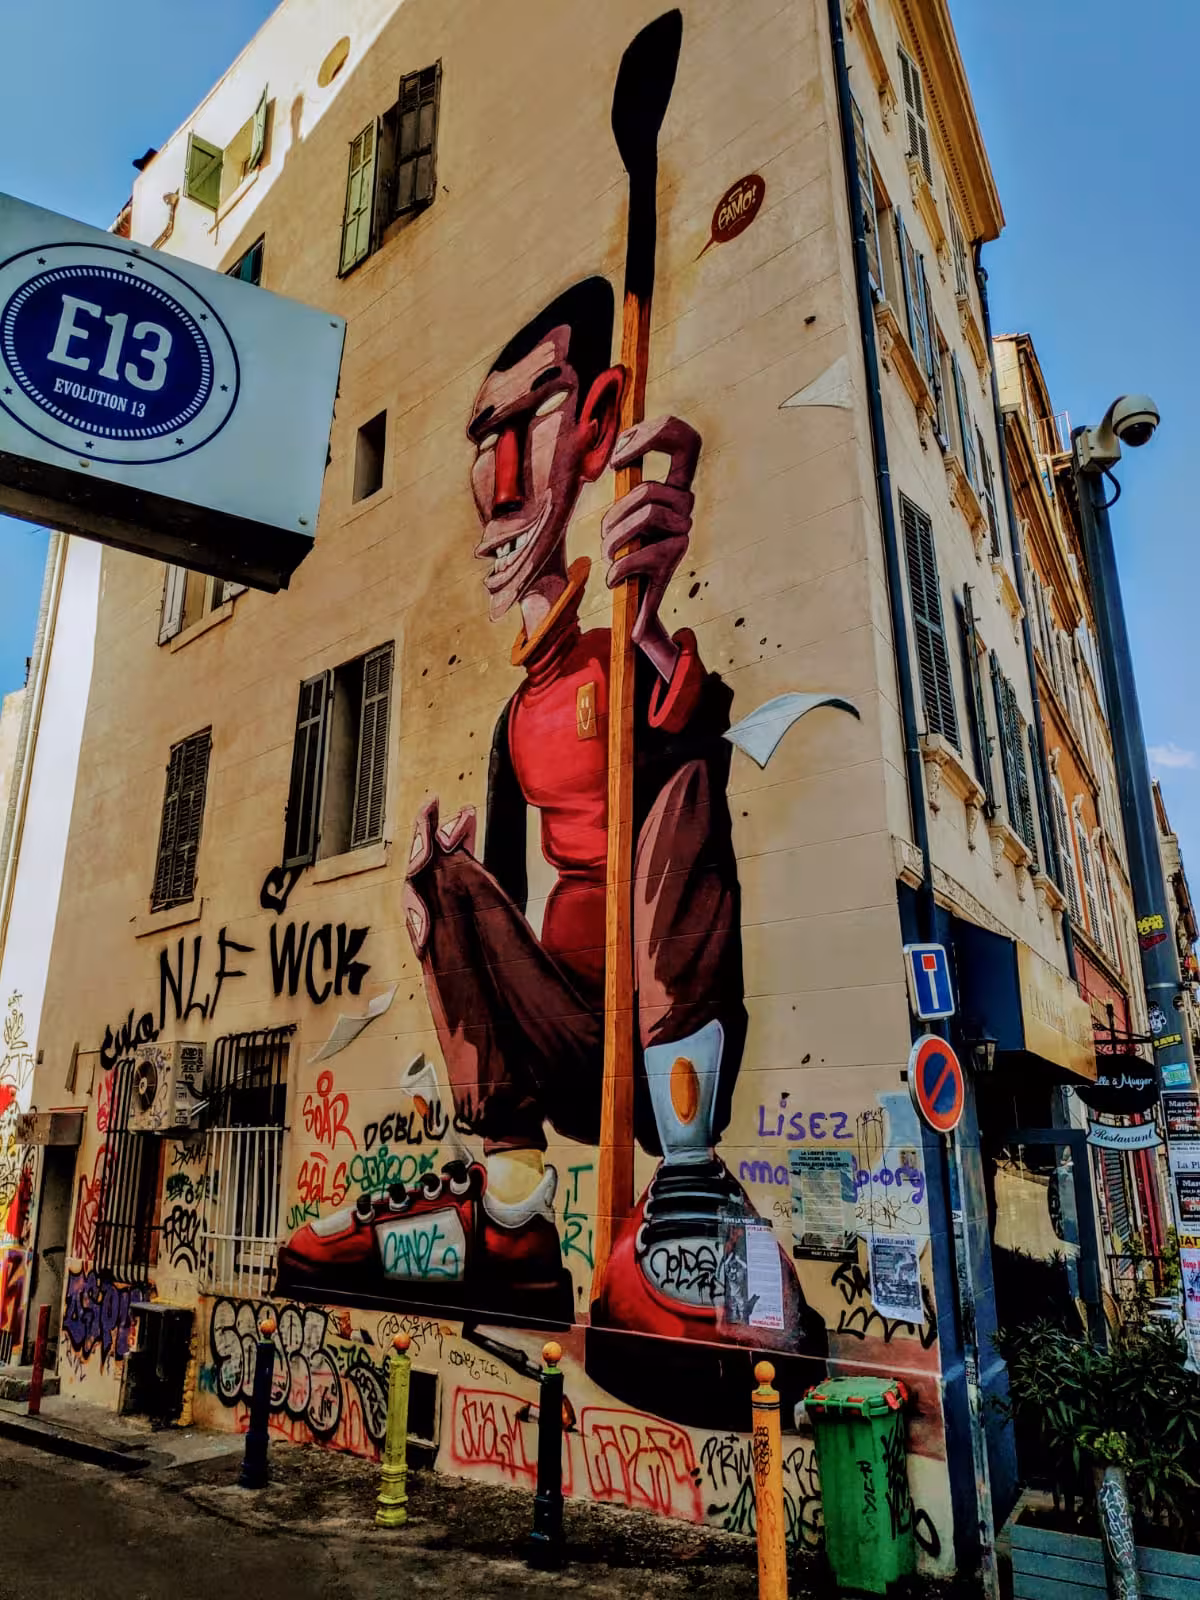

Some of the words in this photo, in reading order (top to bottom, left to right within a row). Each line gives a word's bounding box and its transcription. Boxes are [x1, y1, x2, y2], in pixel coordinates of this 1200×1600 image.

[47, 294, 173, 392] E13
[53, 377, 128, 413] EVOLUTION
[130, 401, 146, 418] 13
[1115, 1072, 1153, 1091] Manger
[1093, 1128, 1153, 1143] Restaurant
